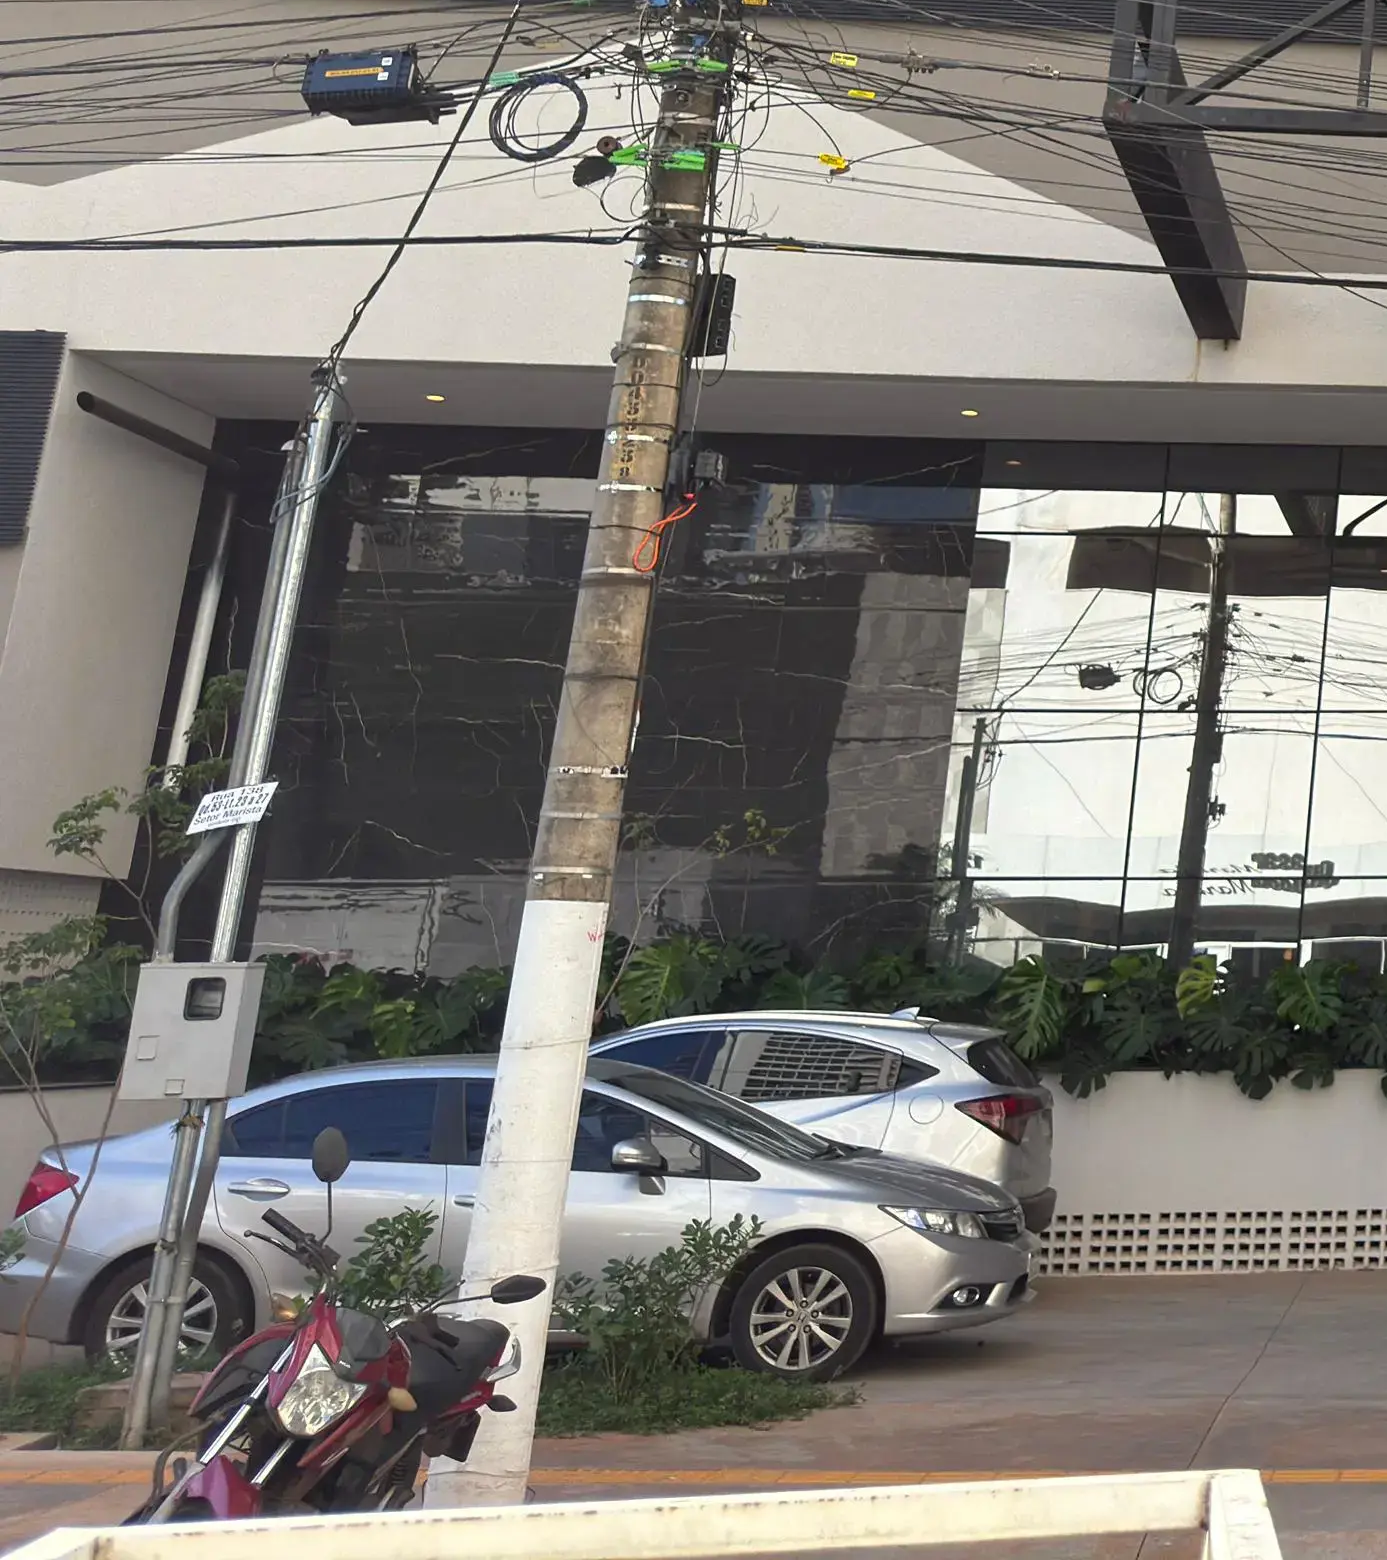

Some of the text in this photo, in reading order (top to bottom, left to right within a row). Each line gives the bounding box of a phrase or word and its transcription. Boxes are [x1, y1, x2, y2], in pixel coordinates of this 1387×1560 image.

[211, 786, 264, 802] Rua 138
[256, 792, 270, 804] 27
[193, 813, 221, 826] Setor
[222, 806, 262, 818] Marista
